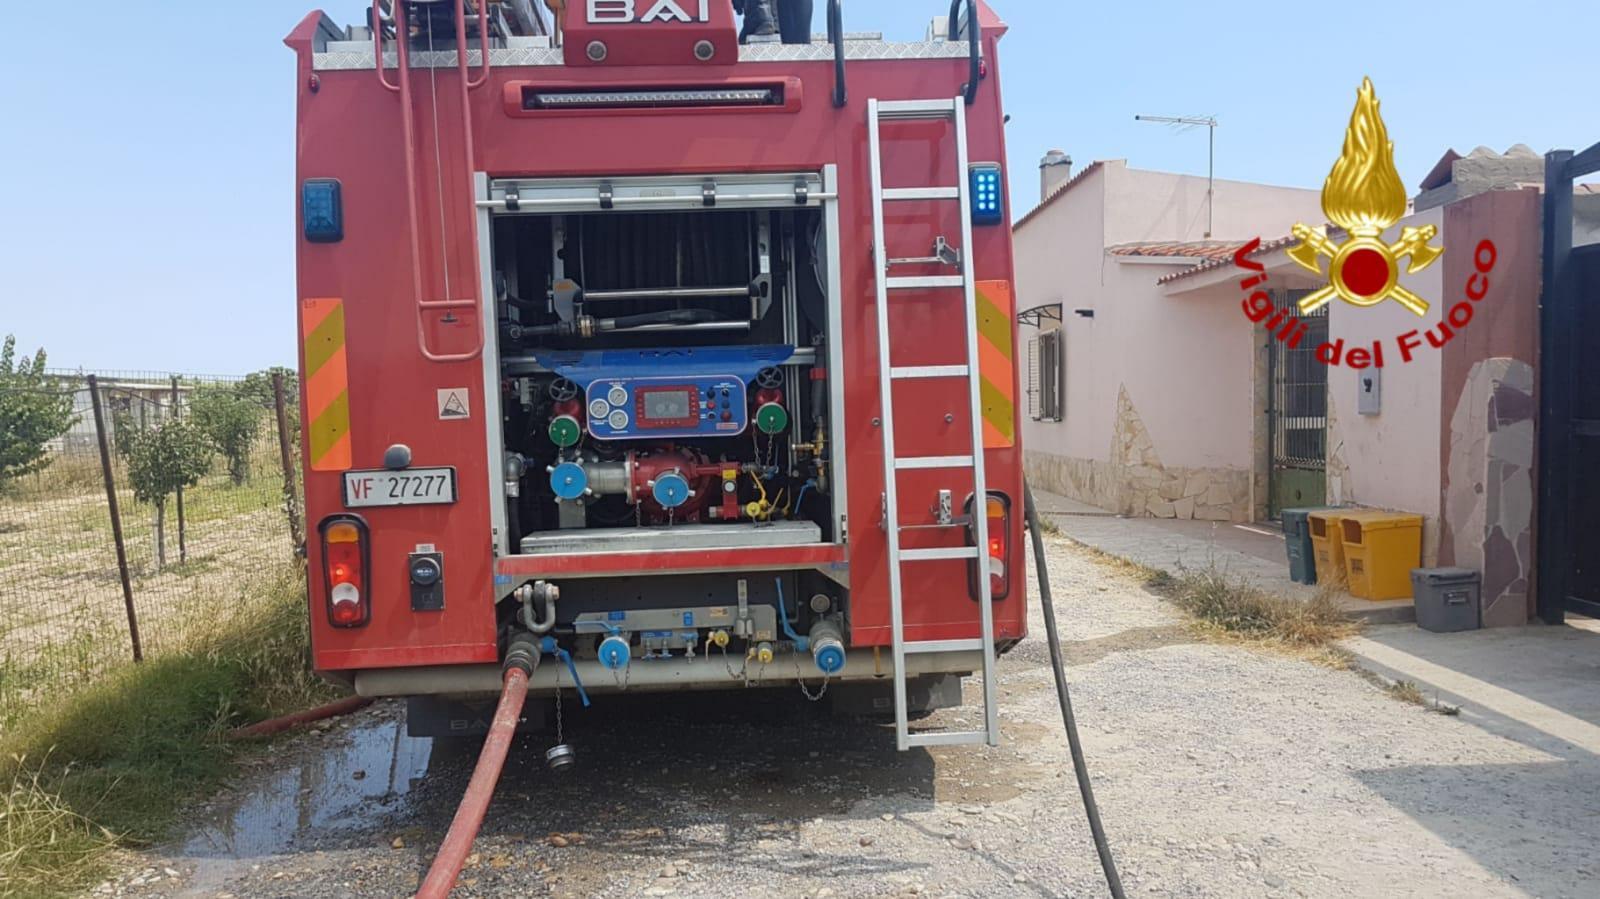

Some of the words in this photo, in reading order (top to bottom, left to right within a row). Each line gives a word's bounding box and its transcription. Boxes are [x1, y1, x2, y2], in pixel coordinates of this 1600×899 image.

[586, 0, 710, 23] BAI
[351, 478, 374, 499] VF
[388, 475, 446, 498] 27277
